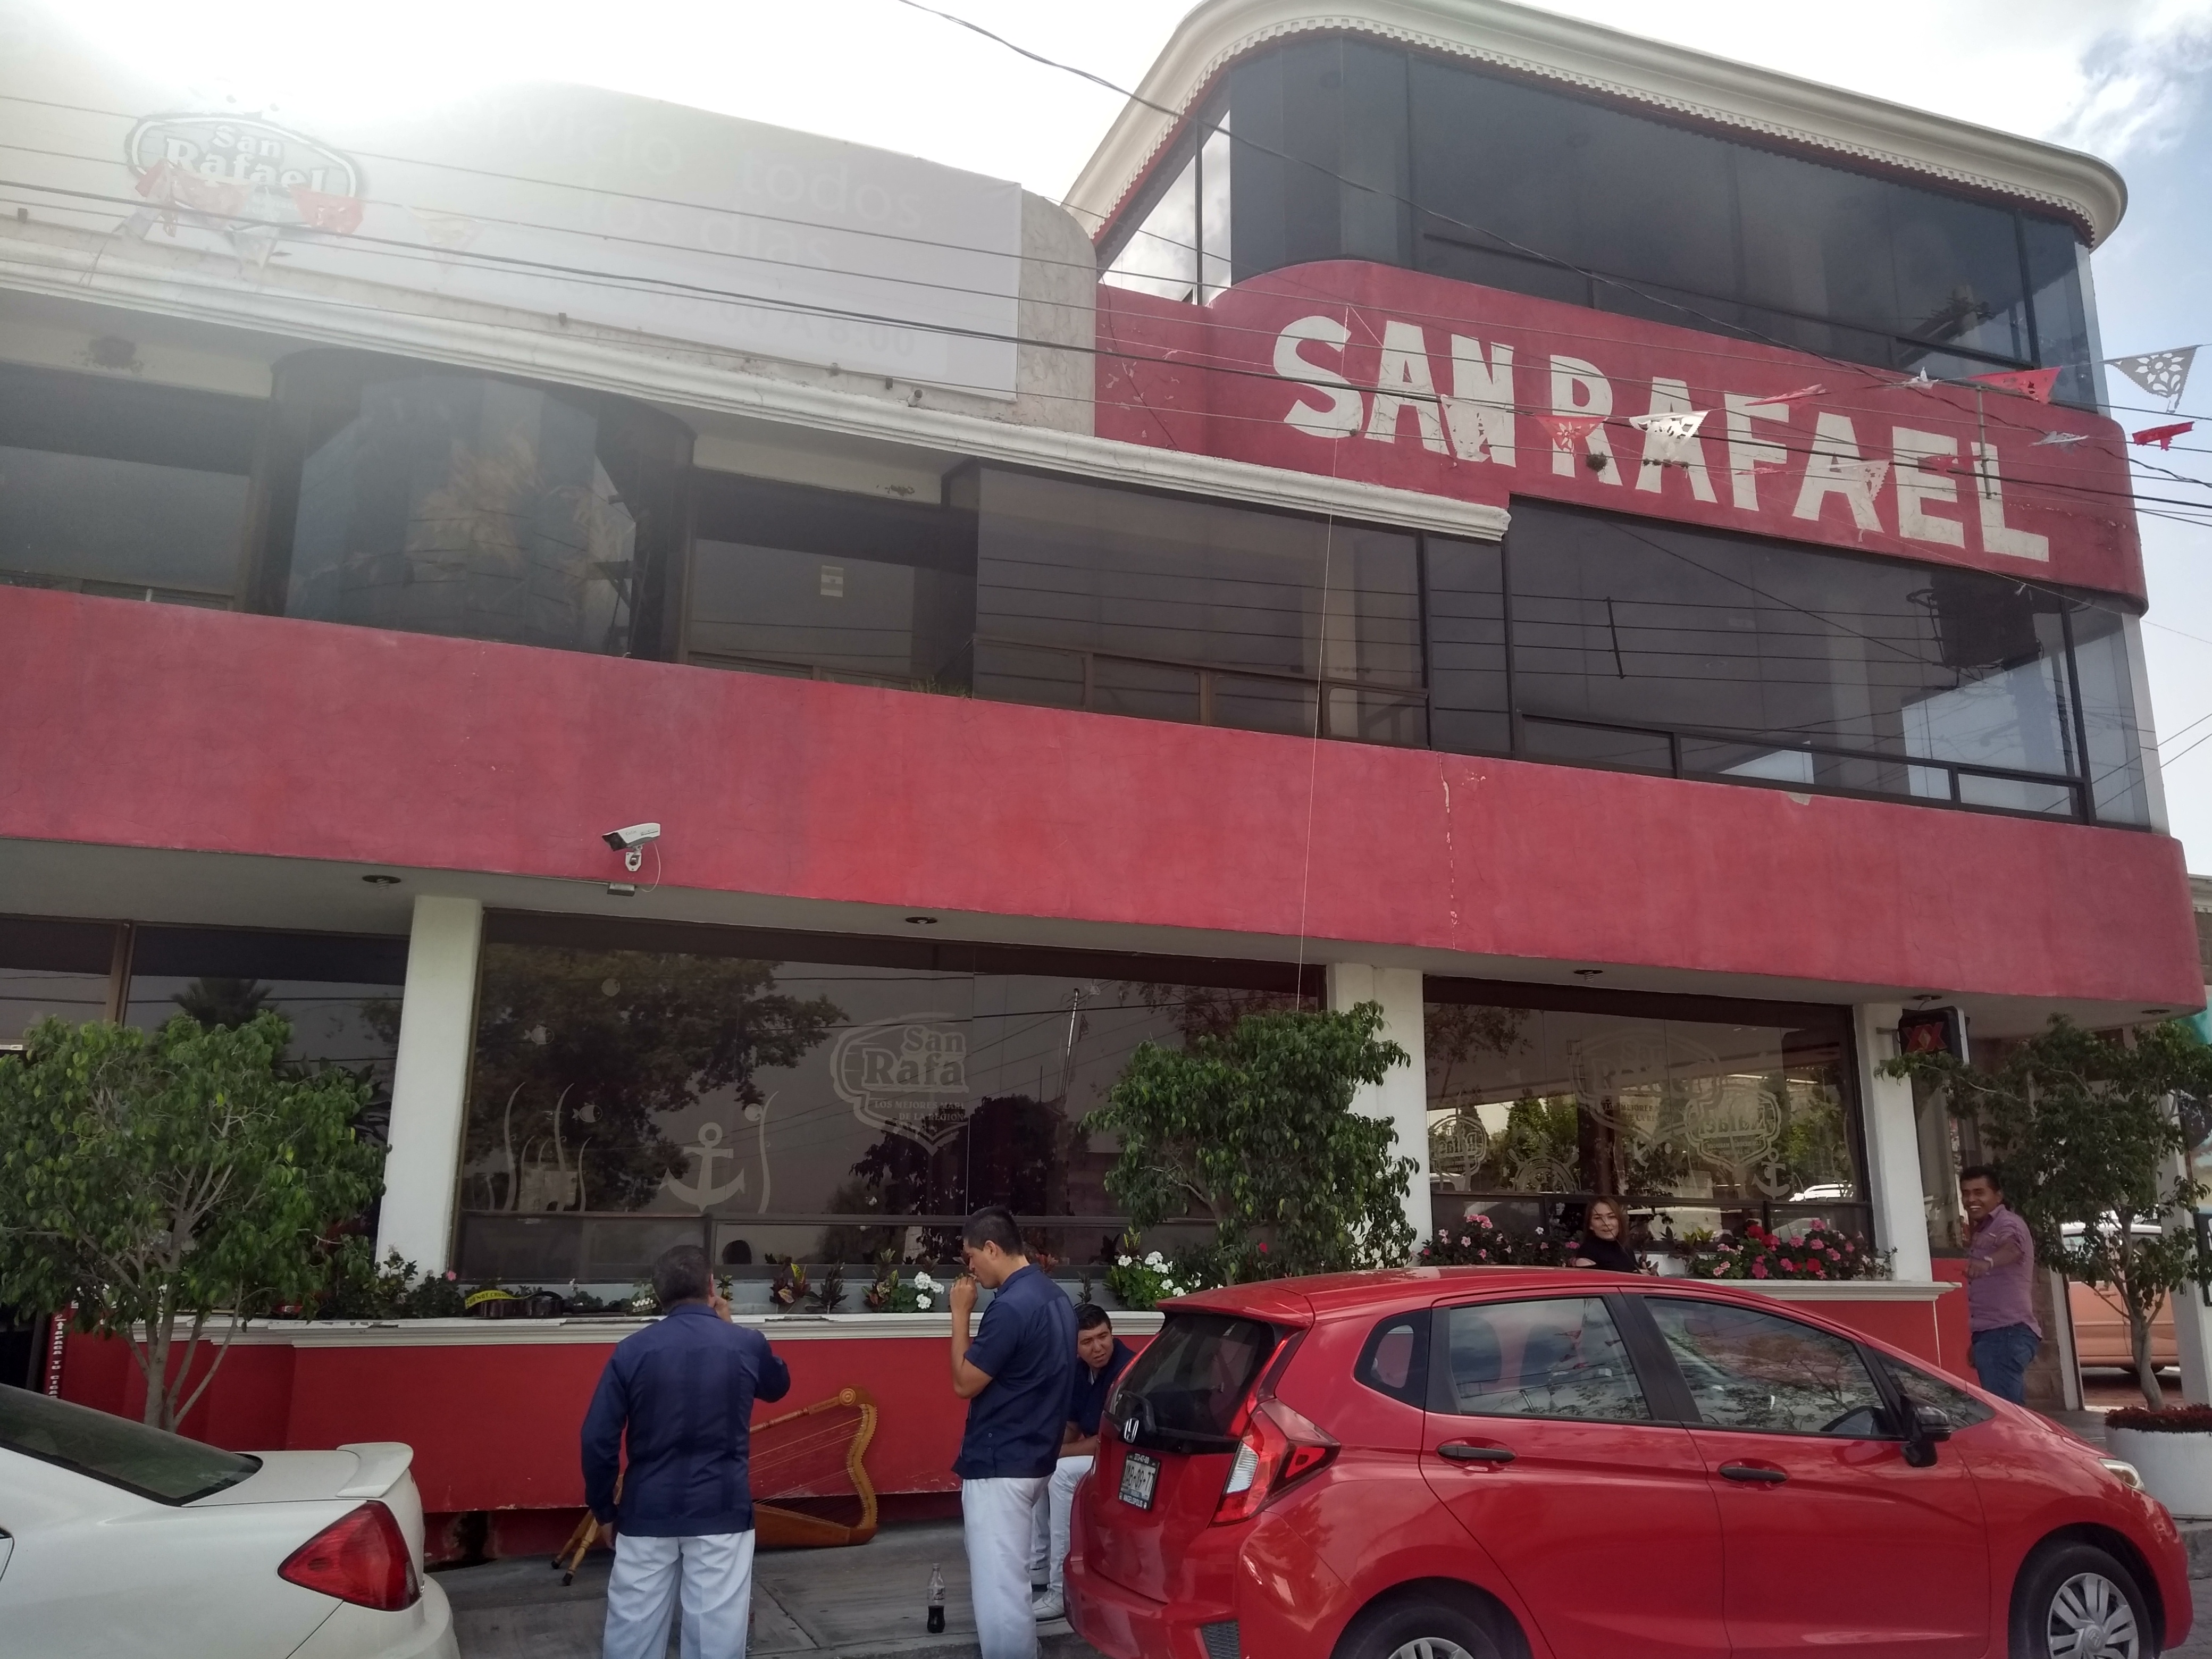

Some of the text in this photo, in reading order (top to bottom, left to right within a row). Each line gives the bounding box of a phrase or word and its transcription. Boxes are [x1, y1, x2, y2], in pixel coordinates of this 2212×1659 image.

[165, 137, 326, 192] Rafael
[213, 124, 282, 158] San
[584, 168, 672, 240] los
[743, 152, 921, 229] todos
[783, 300, 814, 339] A
[827, 306, 915, 357] 8:00
[1274, 314, 2050, 563] SAN RAFAEL
[864, 1050, 963, 1085] Rafa
[904, 1027, 963, 1052] San
